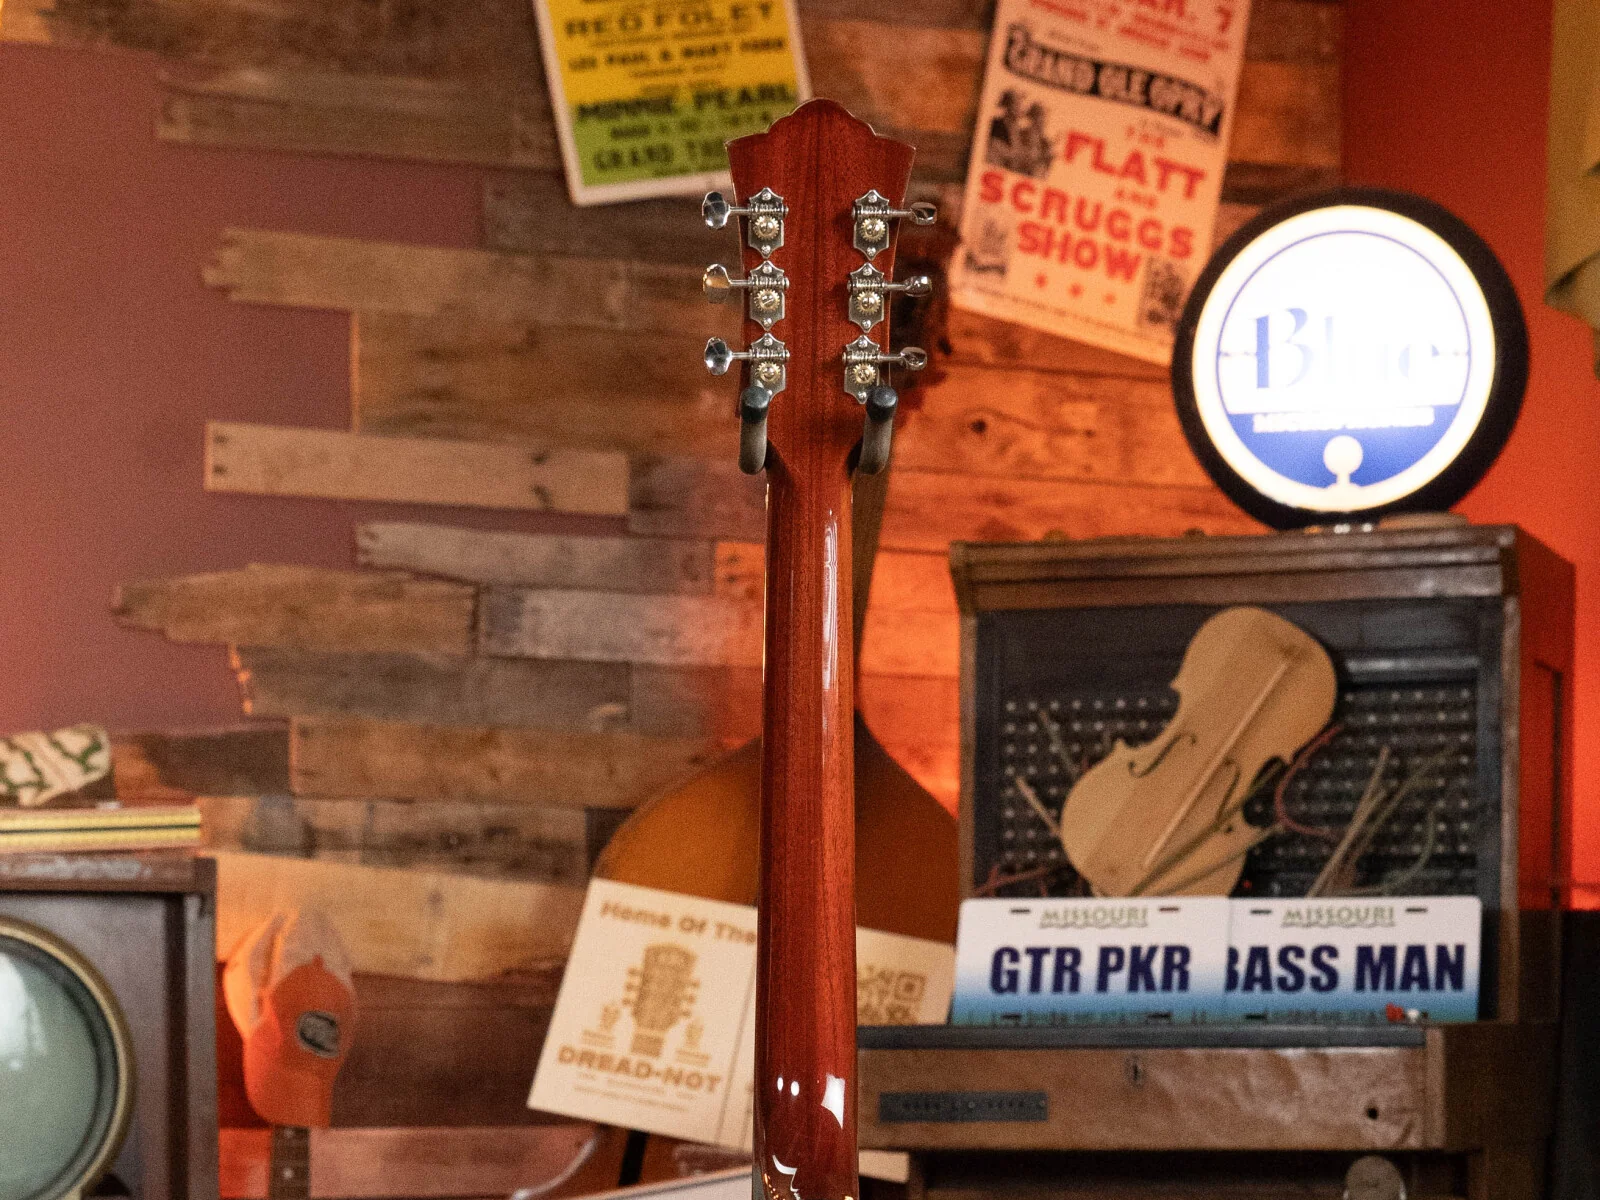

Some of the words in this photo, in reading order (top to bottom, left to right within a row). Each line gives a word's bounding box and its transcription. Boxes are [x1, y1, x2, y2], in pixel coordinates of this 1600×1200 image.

[1064, 131, 1206, 201] FLATT
[979, 170, 1195, 260] SCRUGGS
[1114, 187, 1158, 209] AND
[1017, 220, 1142, 284] SHOW
[1252, 307, 1441, 389] Ble
[601, 901, 672, 929] Home
[715, 921, 757, 945] The
[1042, 906, 1148, 924] MISSOURI
[1283, 905, 1396, 924] MISSOURI
[990, 946, 1082, 994] GTR
[1096, 945, 1191, 993] PKR
[1354, 944, 1466, 992] MAN
[557, 1044, 722, 1093] DREAD-NOT
